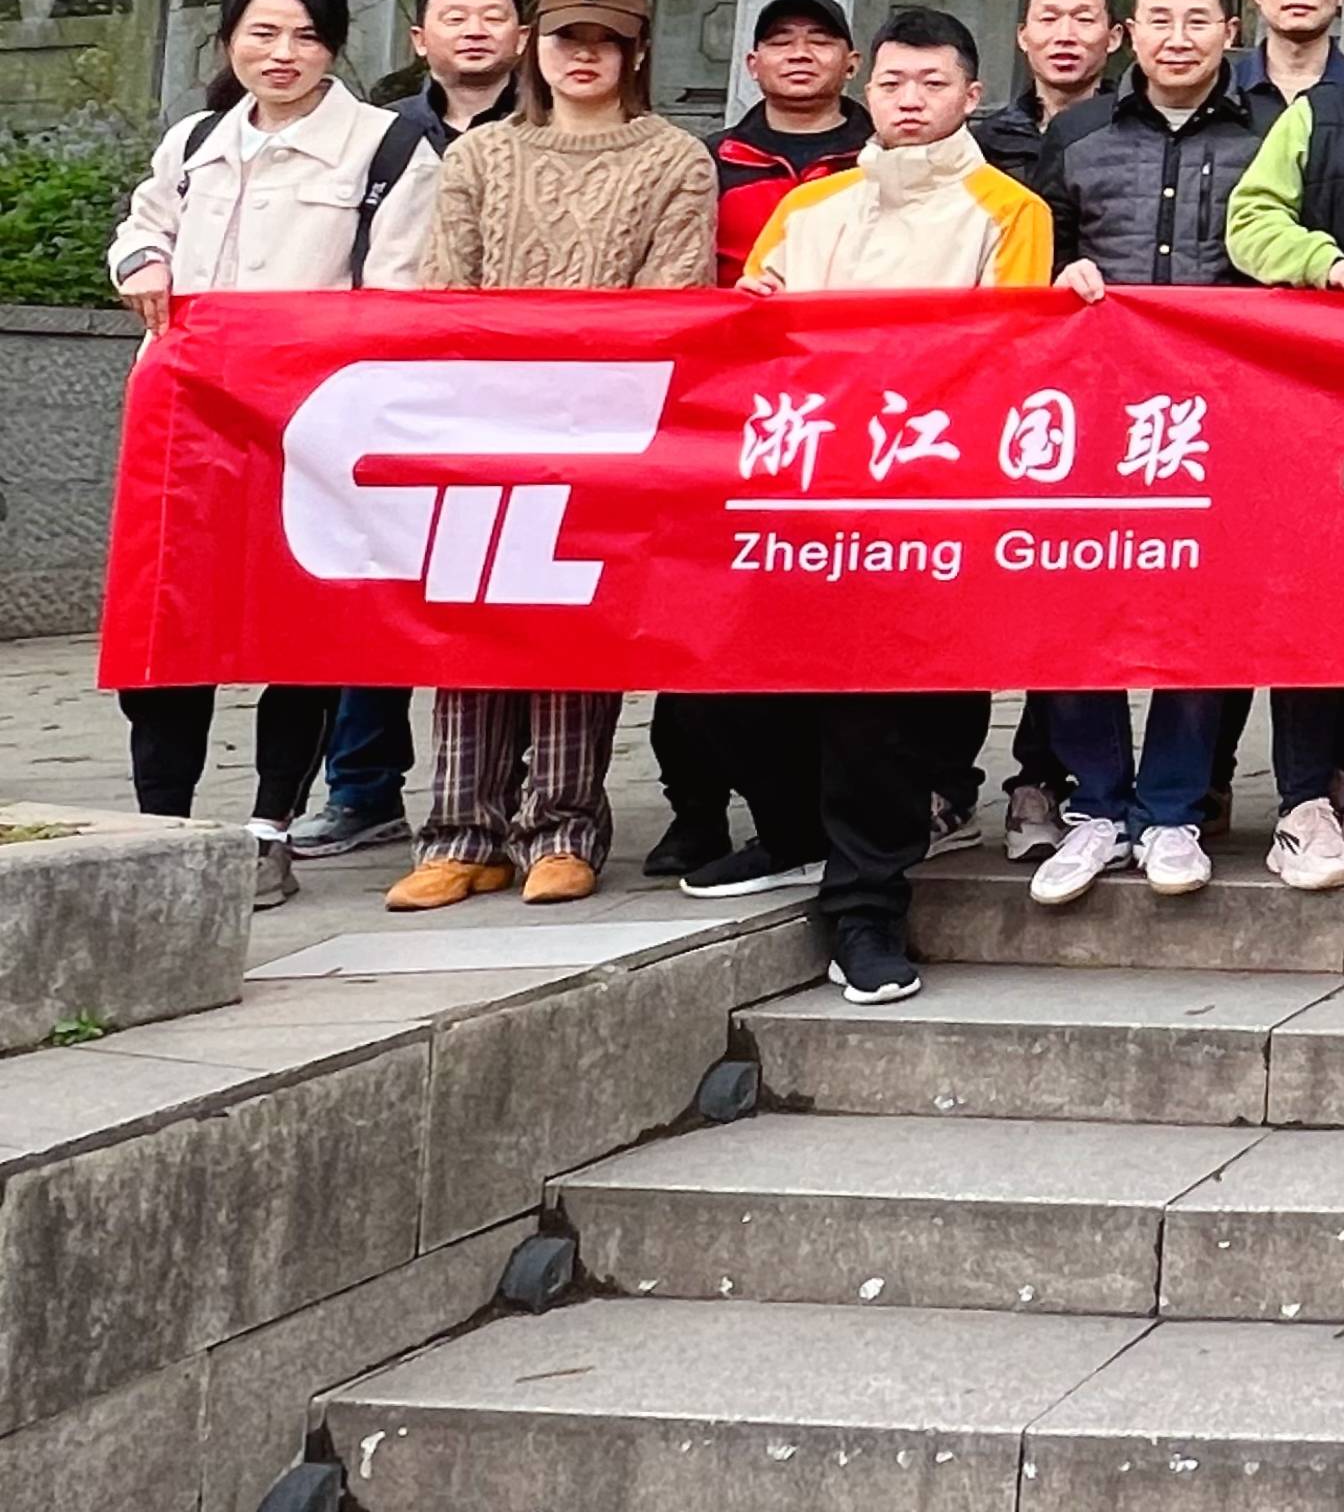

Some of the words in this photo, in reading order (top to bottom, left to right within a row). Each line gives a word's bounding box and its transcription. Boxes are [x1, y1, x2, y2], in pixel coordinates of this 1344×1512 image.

[739, 389, 1210, 491] 浙江国联
[732, 533, 961, 581] Zhejiang
[994, 530, 1199, 571] Guolian
